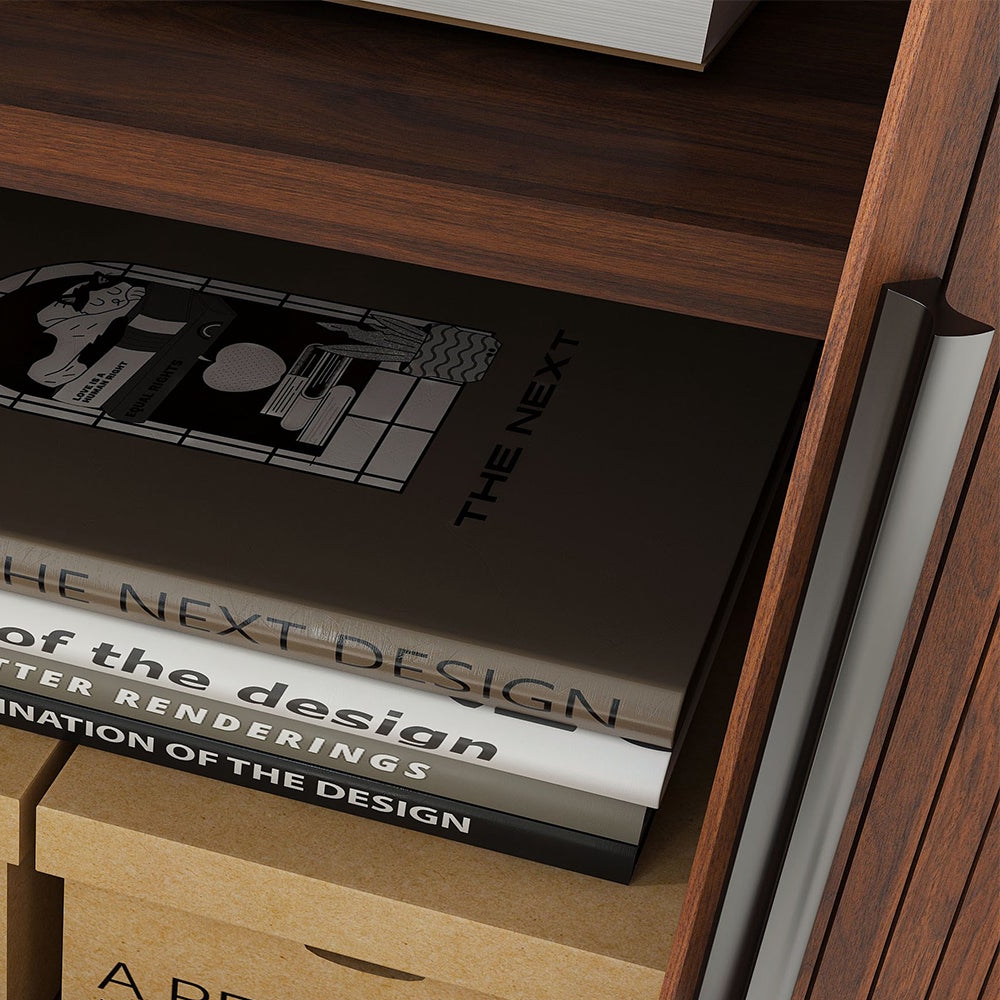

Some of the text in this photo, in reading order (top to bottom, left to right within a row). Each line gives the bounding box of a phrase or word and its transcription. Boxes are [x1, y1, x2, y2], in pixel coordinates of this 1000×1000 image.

[73, 384, 93, 401] LOVE
[89, 377, 100, 385] IS
[82, 361, 128, 403] HUMAN RIGHT
[125, 359, 184, 417] EQUAL RIGHTS
[454, 329, 579, 526] THE NEXT
[92, 642, 211, 691] the
[237, 682, 498, 761] design
[119, 582, 306, 651] NEXT
[333, 634, 620, 730] DESIGN
[114, 688, 432, 780] RENDERINGS
[165, 743, 219, 767] OF
[227, 756, 304, 792] THE
[316, 780, 472, 834] DESIGN
[97, 962, 144, 1000] A
